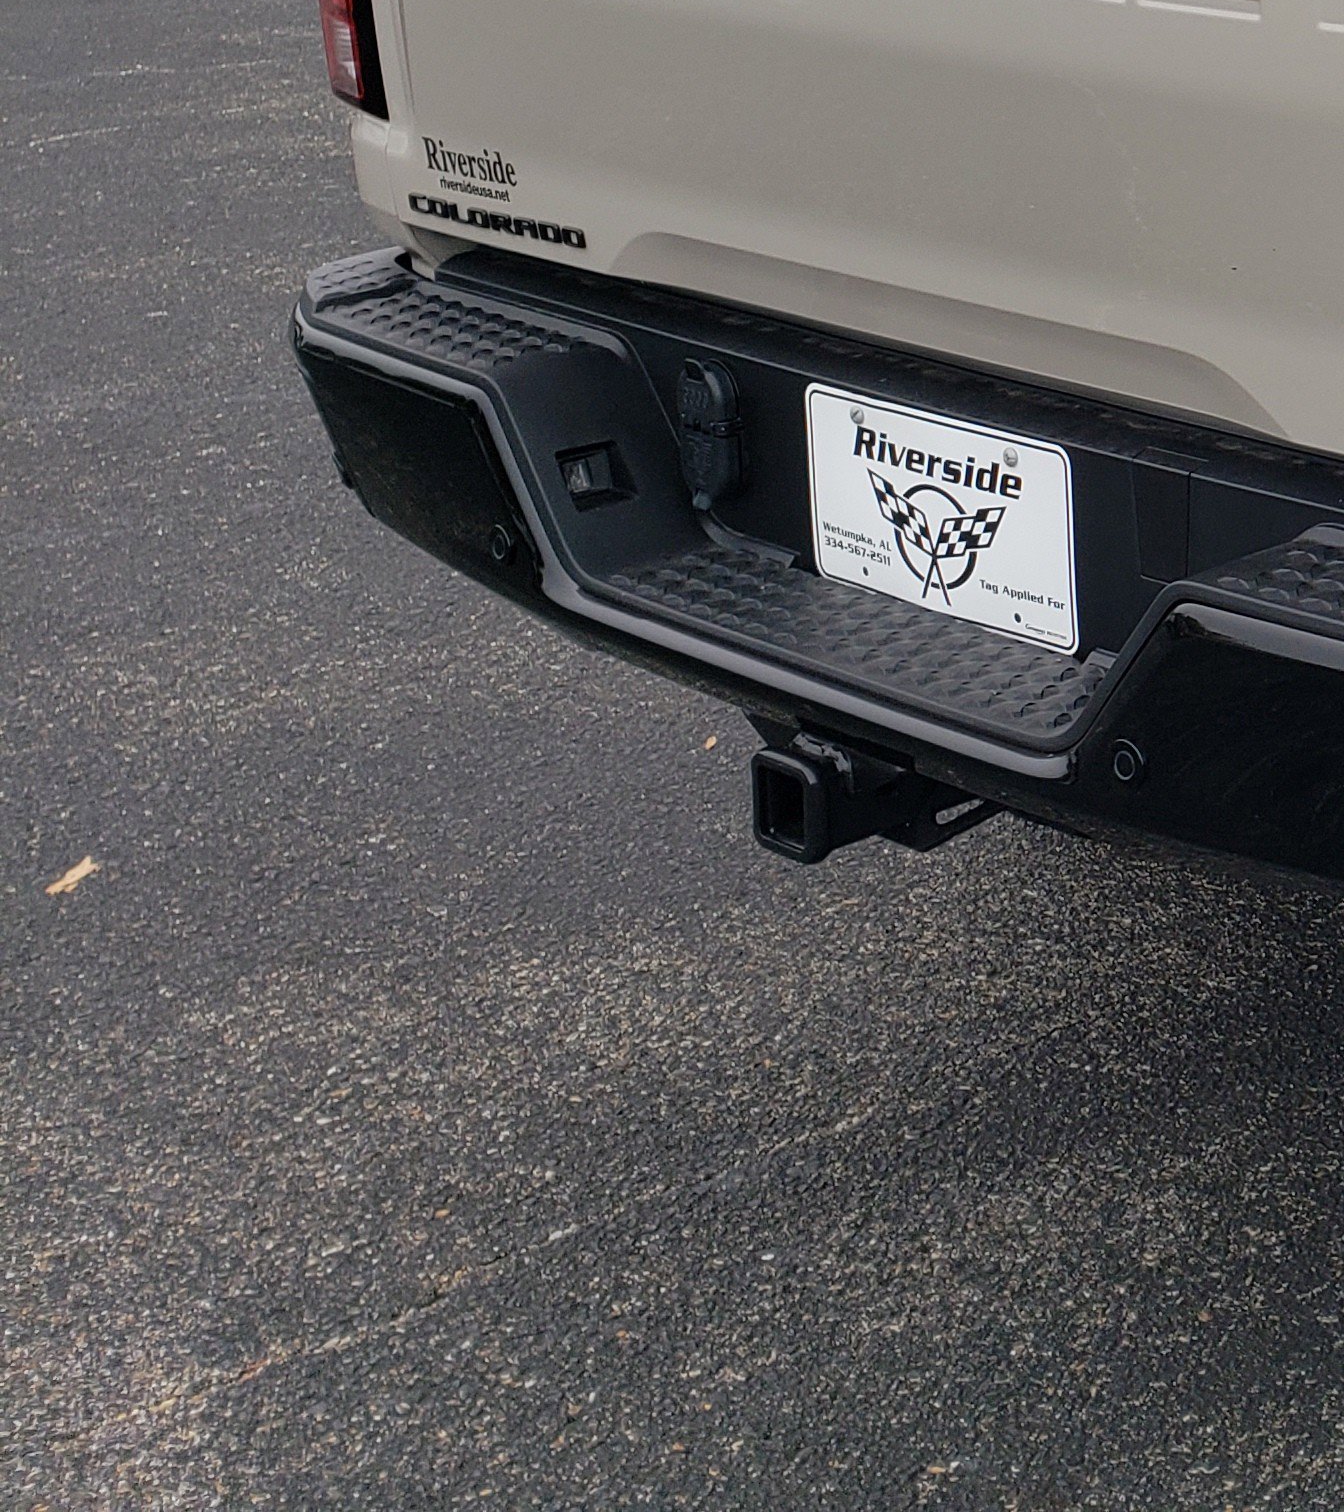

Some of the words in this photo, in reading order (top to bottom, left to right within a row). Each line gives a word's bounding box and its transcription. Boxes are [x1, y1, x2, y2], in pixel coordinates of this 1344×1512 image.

[421, 136, 518, 186] Riverside
[439, 175, 511, 203] riversideusa.net
[407, 191, 588, 249] COLORADO
[853, 425, 1024, 500] Riverside
[822, 520, 877, 548] Wetumpka,
[879, 539, 893, 552] AL
[823, 534, 892, 567] 334-567-2511
[979, 578, 999, 595] Tag
[1001, 585, 1044, 605] Applied
[1046, 596, 1066, 610] For
